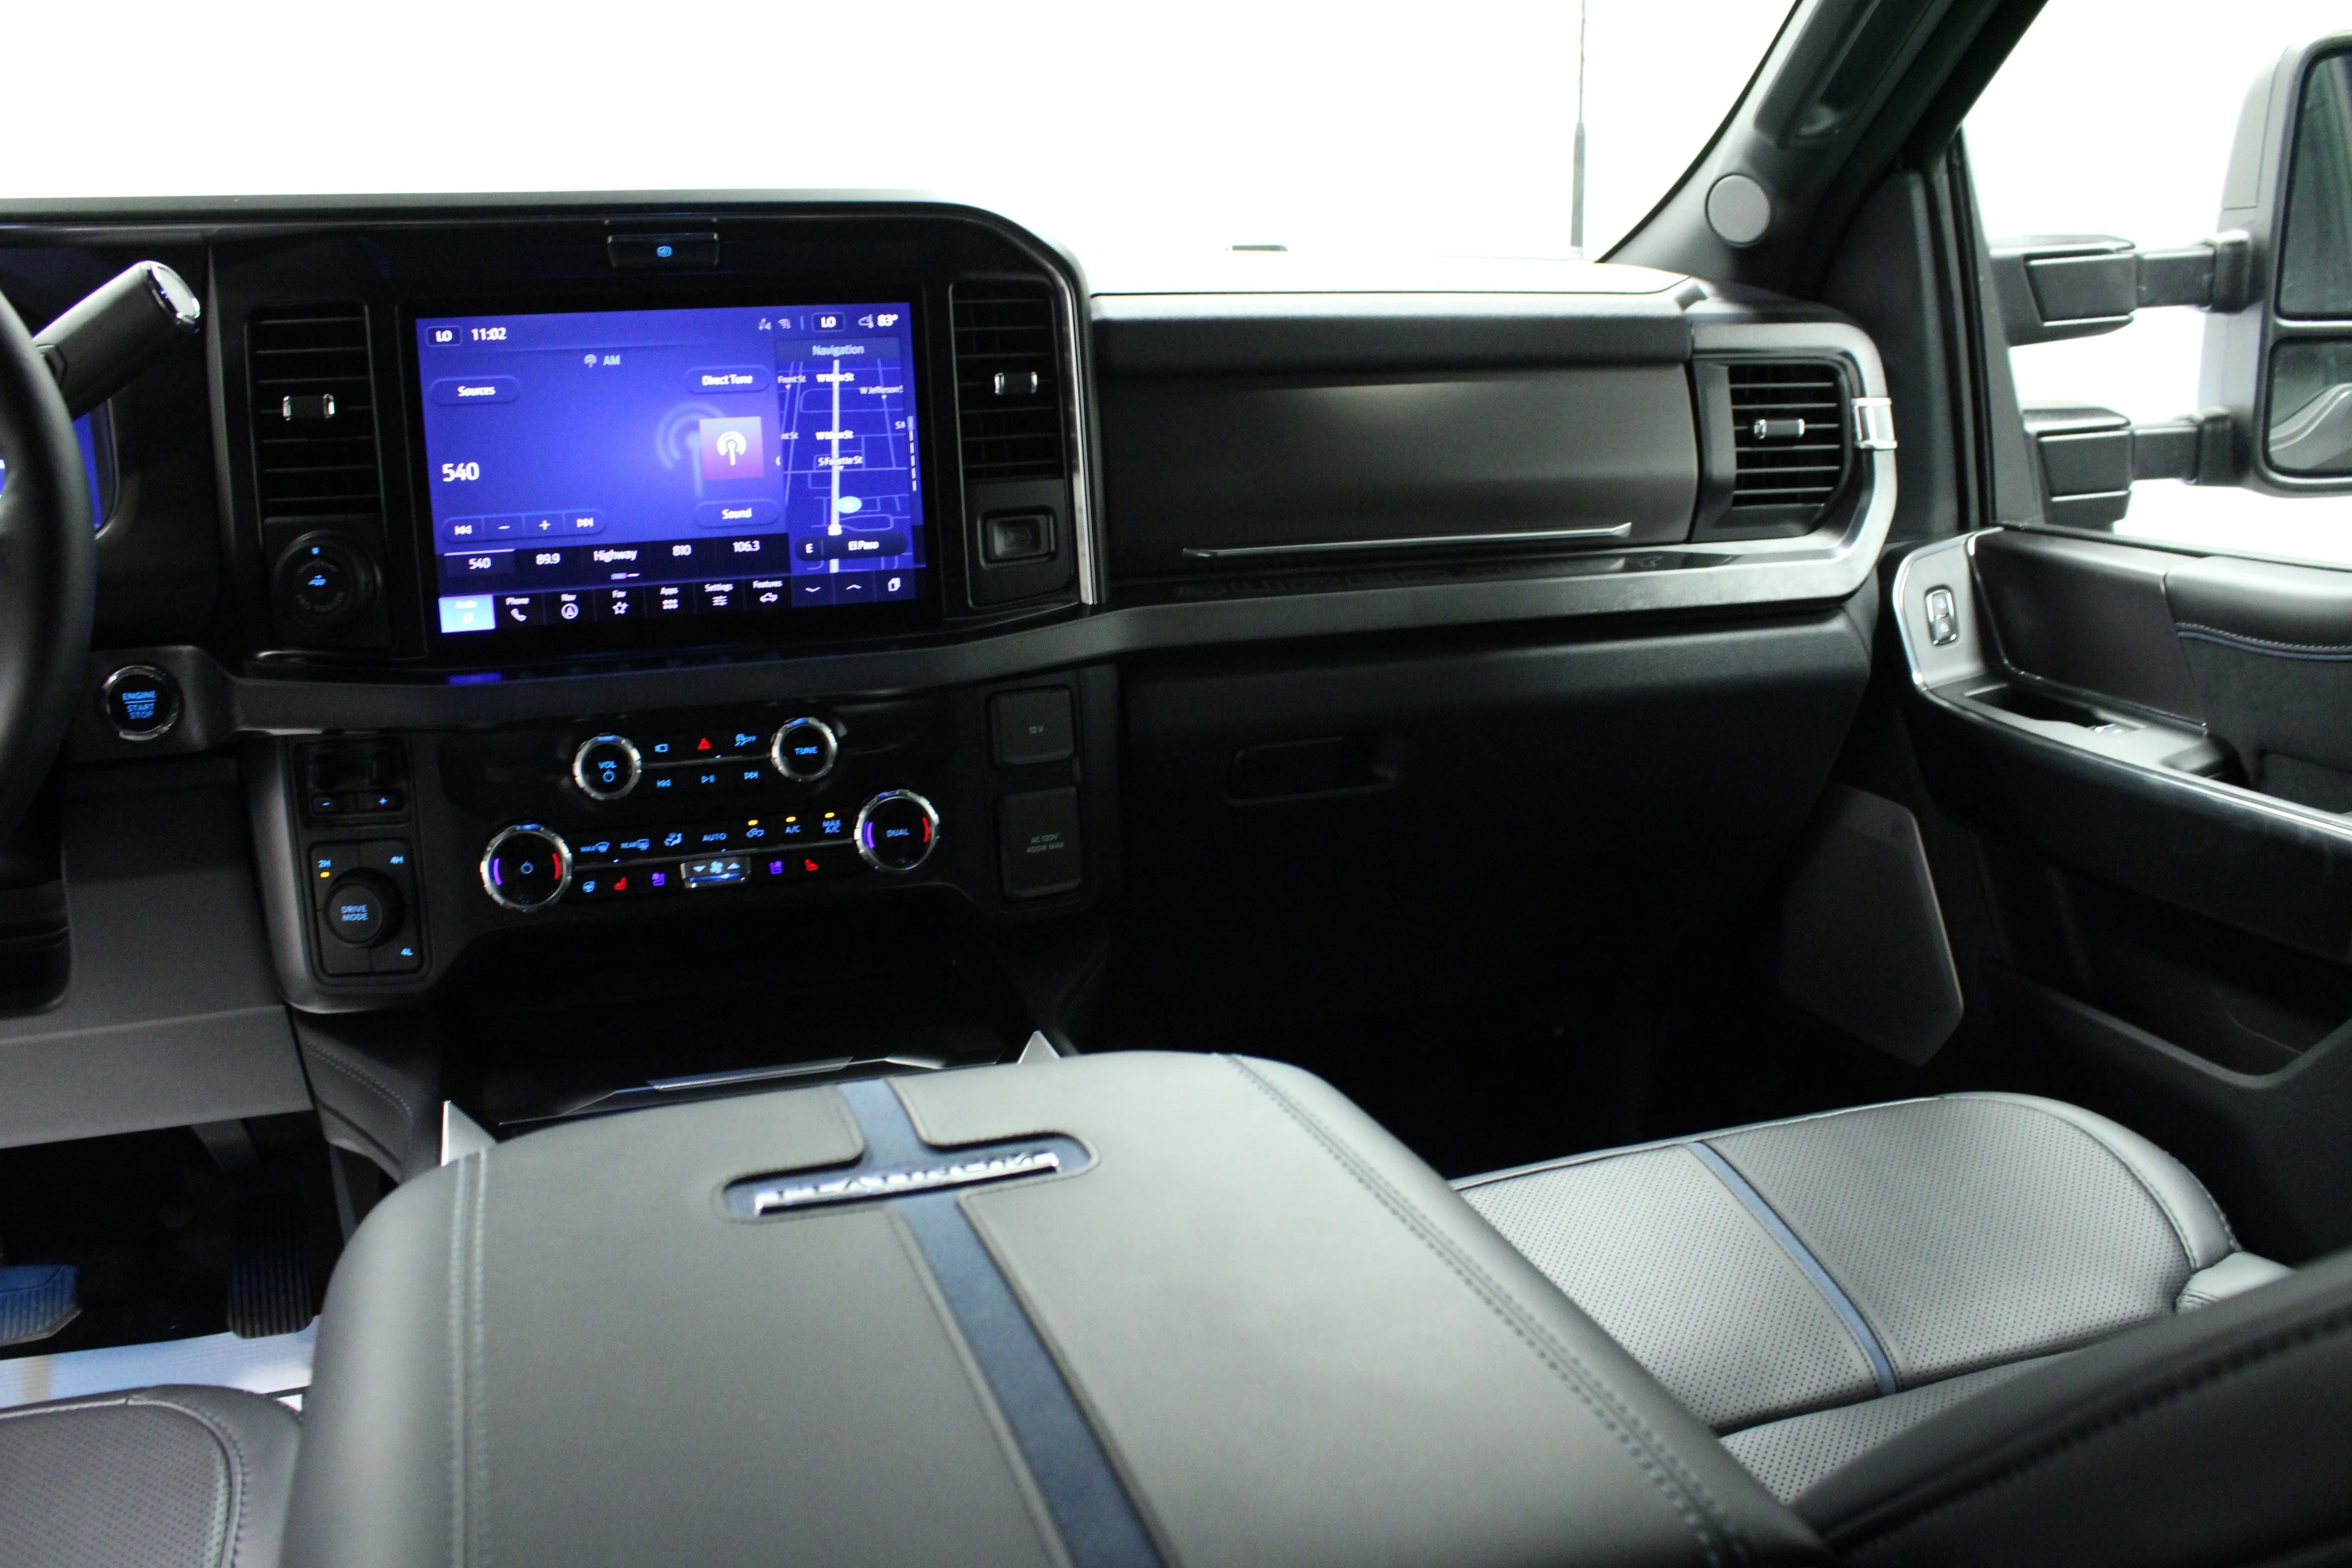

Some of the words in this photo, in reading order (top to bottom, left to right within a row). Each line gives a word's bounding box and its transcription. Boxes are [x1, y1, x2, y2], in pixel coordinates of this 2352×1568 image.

[821, 316, 837, 328] LO
[436, 331, 453, 342] LO
[471, 327, 507, 341] 11:02
[812, 345, 864, 357] Navigation
[603, 355, 621, 366] AM
[701, 374, 729, 387] Direct
[730, 374, 753, 385] Tune
[458, 386, 496, 398] Sources
[442, 462, 480, 482] 540
[721, 508, 752, 520] Sound
[672, 544, 692, 557] 810
[732, 541, 760, 553] 106.3
[805, 543, 814, 554] E
[857, 541, 880, 551] Paso
[535, 553, 561, 566] 89.9
[593, 549, 638, 563] Highway
[468, 557, 492, 570] 540
[752, 580, 783, 589] Features
[612, 590, 627, 598] Fav
[661, 587, 679, 596] Apps
[505, 596, 530, 606] Phone
[561, 593, 577, 602] Nav
[744, 734, 757, 743] OFF
[794, 745, 818, 755] TUNE
[598, 761, 618, 769] VOL
[785, 825, 801, 834] A/C
[886, 828, 910, 837] DUAL
[702, 832, 728, 842] AUTO
[318, 859, 332, 868] 2H
[390, 855, 404, 864] 4H
